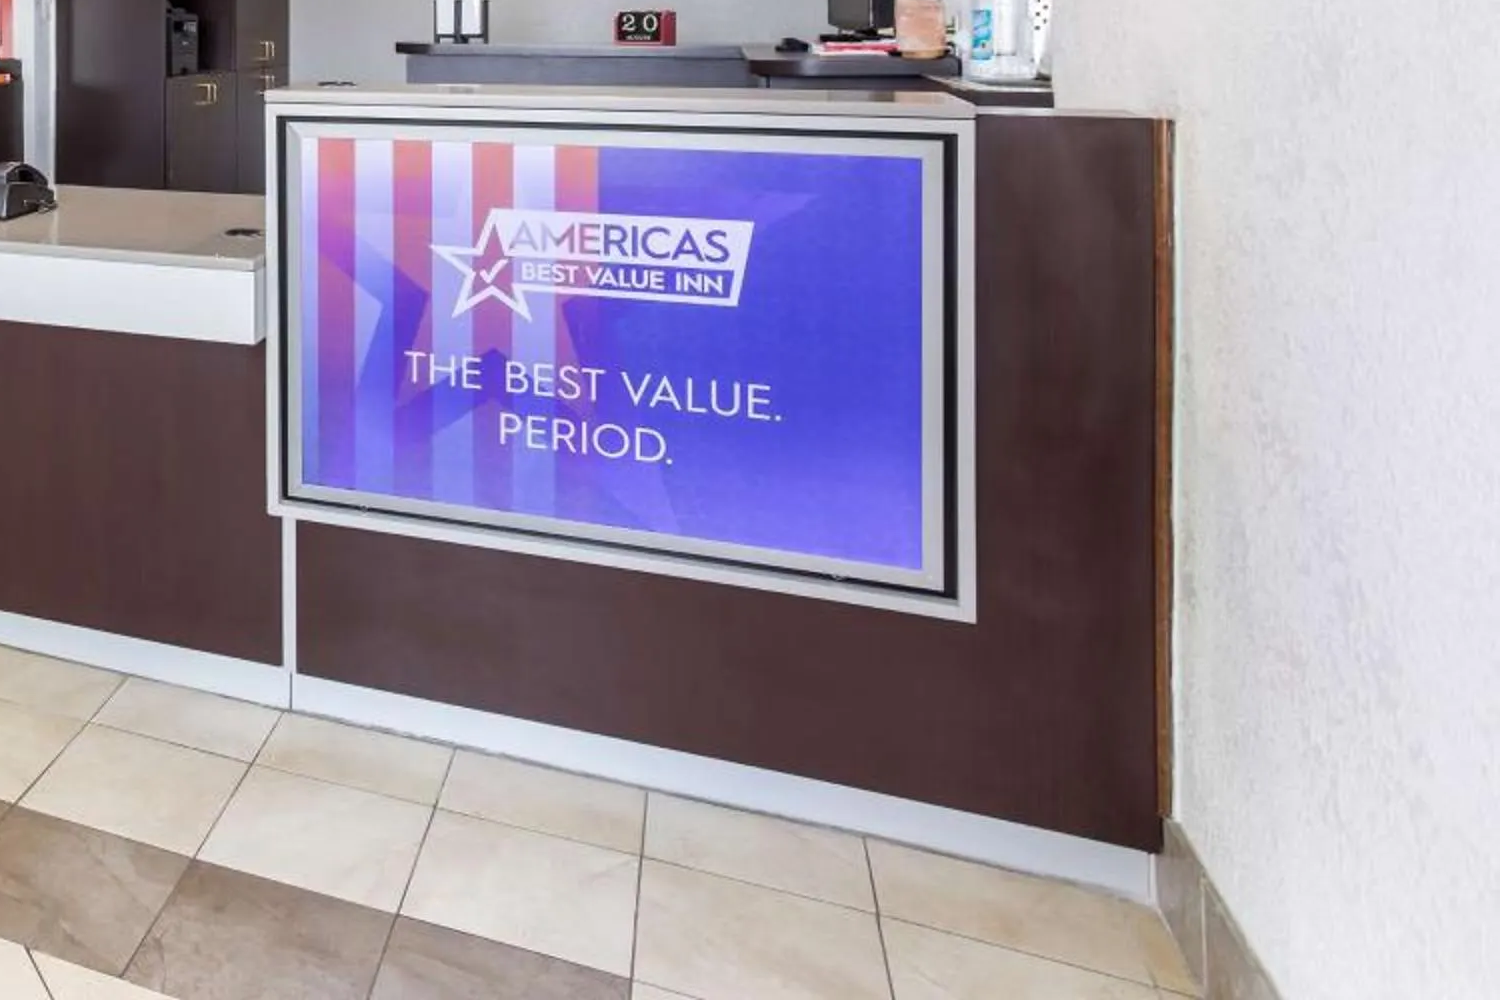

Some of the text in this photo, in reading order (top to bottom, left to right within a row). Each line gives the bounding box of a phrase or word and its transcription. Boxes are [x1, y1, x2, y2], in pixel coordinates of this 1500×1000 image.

[509, 220, 729, 263] AMERICAS
[521, 263, 724, 295] BEST VALUE INN
[405, 351, 782, 422] THE BEST VALUE.
[500, 413, 673, 465] PERIOD.
